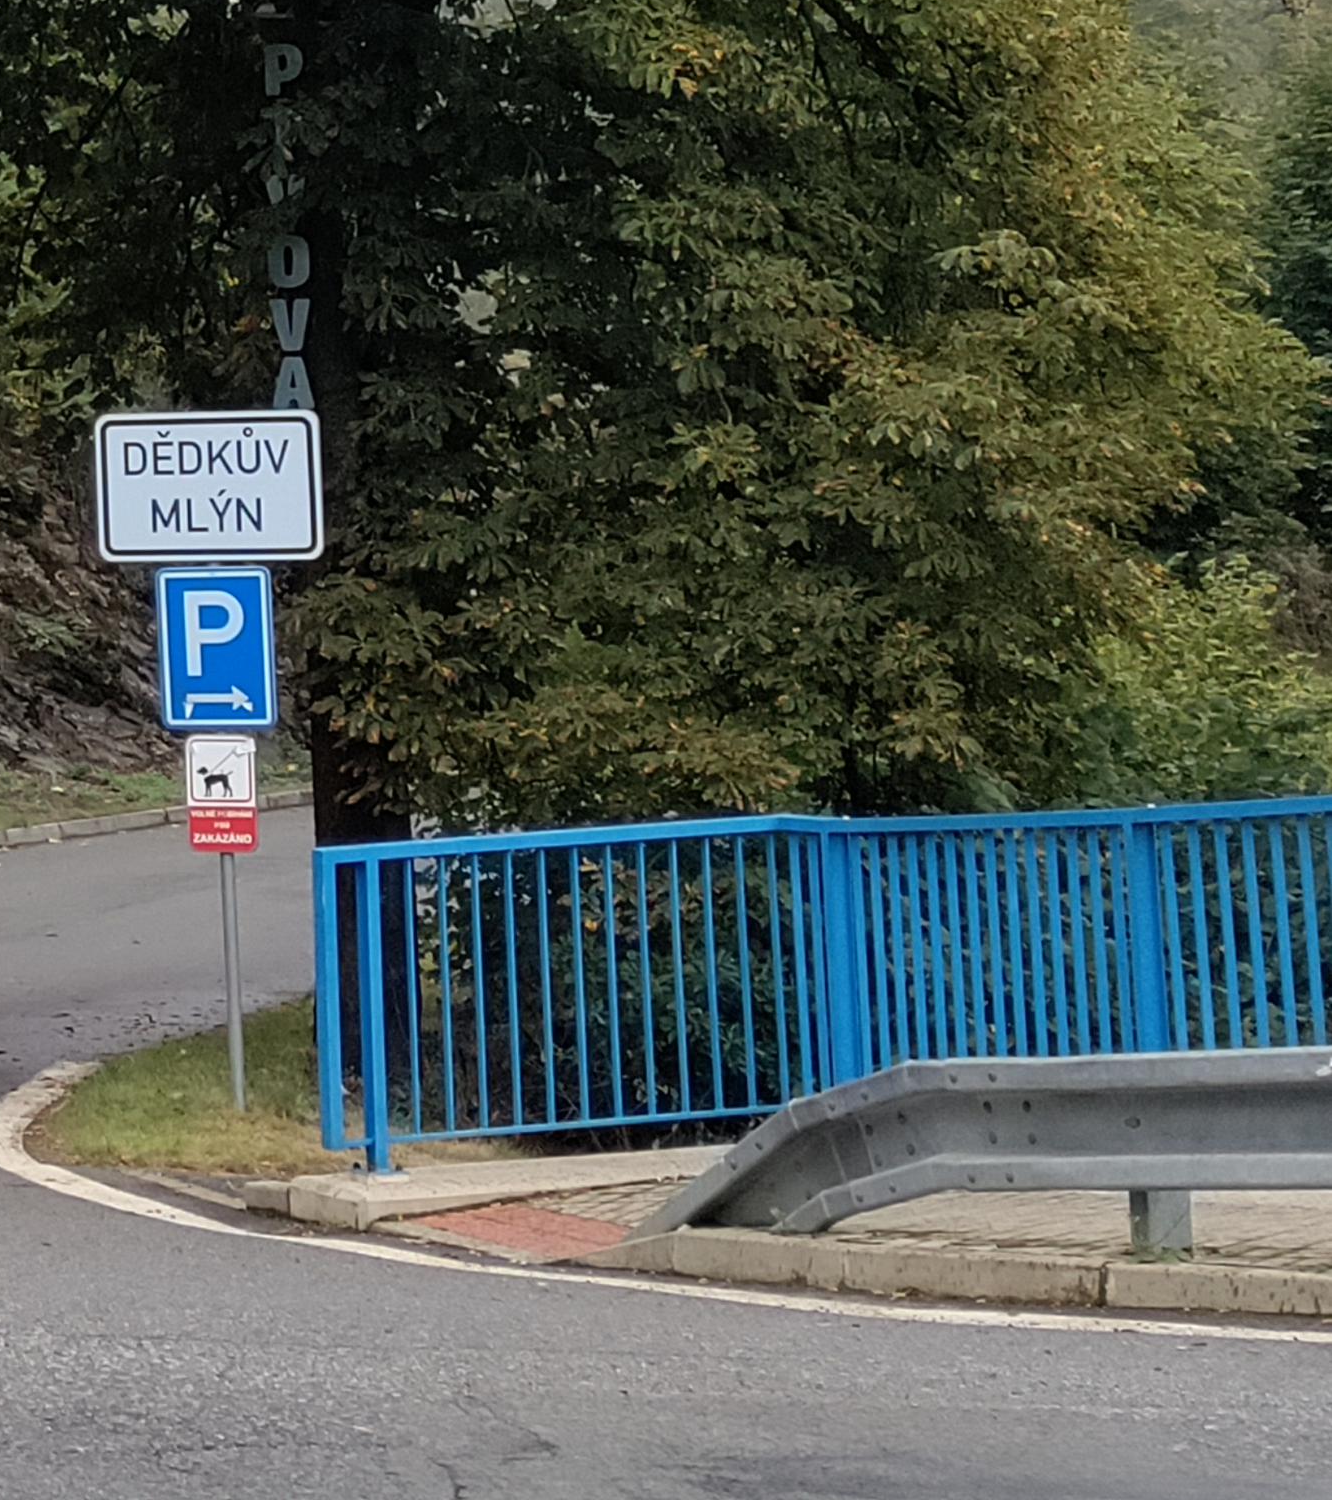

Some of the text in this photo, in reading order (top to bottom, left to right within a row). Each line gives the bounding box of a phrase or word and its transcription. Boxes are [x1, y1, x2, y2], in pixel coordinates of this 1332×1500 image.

[123, 426, 290, 477] DĚDKŮV
[150, 488, 263, 533] MLÝN
[182, 590, 245, 678] P
